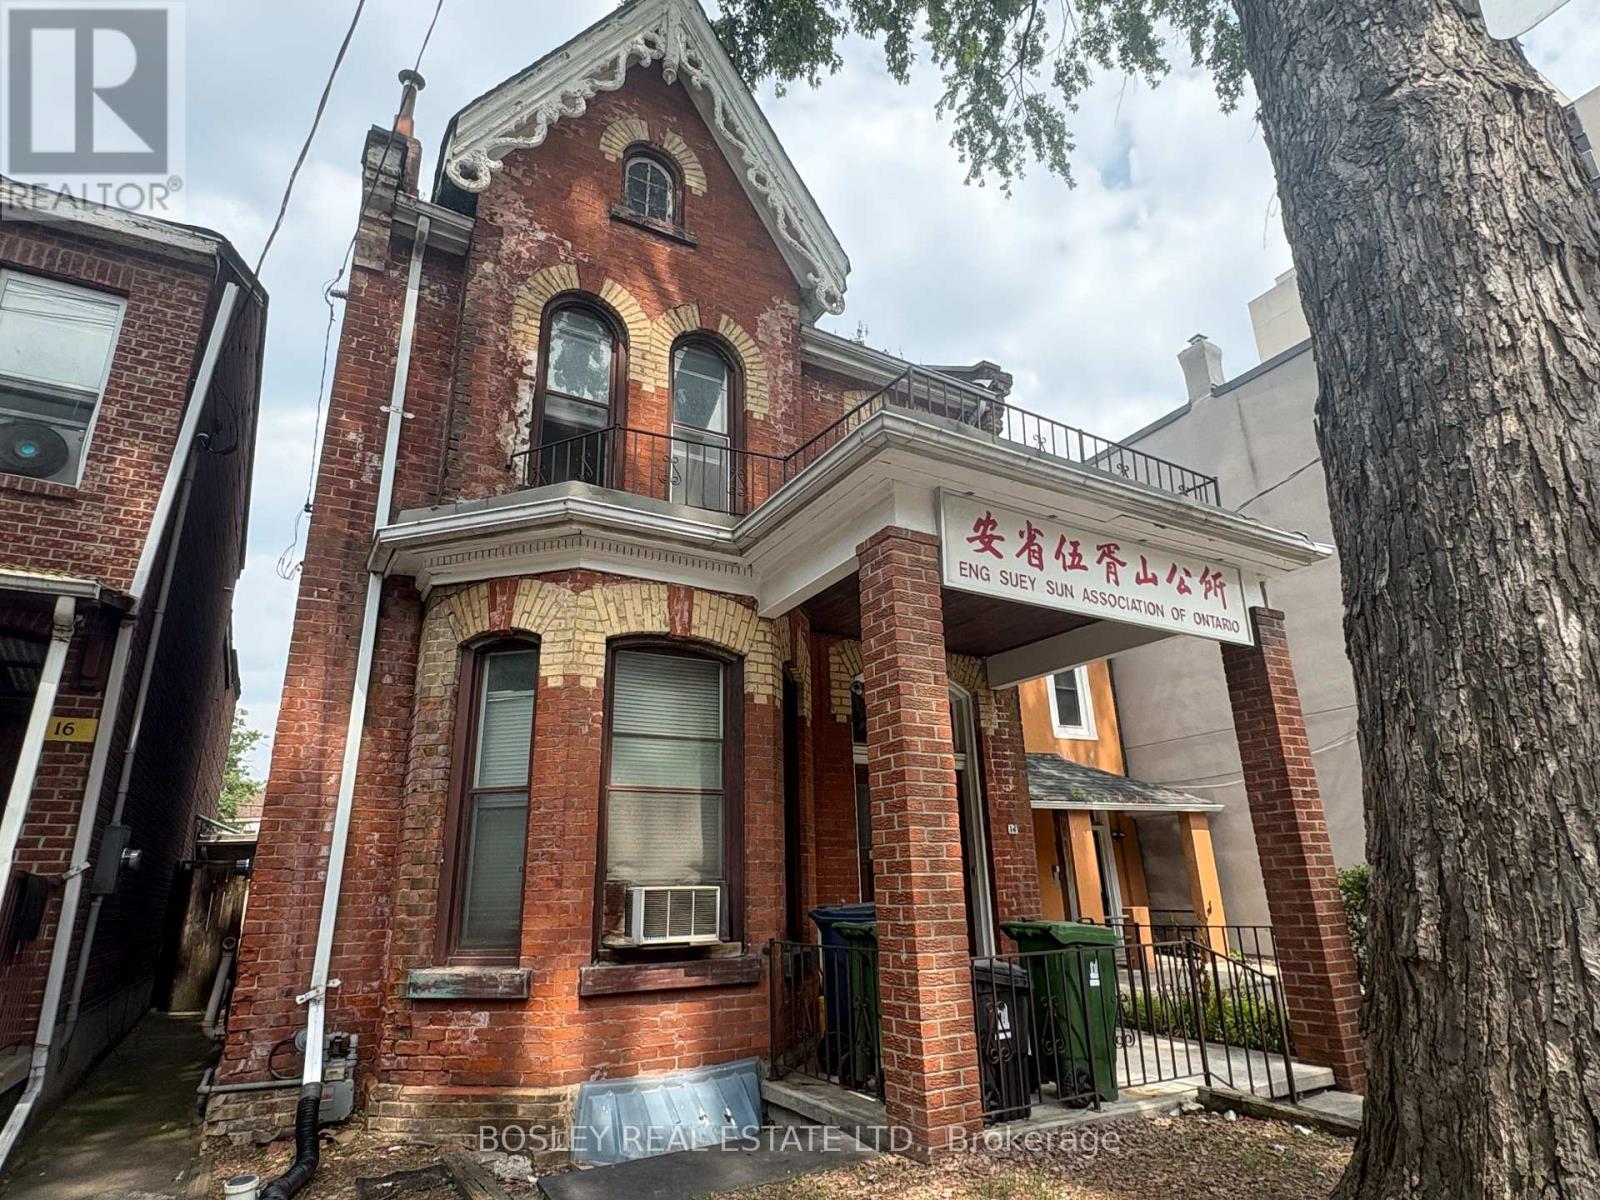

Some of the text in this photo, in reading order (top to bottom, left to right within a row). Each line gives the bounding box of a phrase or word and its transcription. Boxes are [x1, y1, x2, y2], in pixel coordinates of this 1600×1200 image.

[959, 560, 1241, 633] ENG SUEY SUN ASSOCIATION OF ONTARIO
[966, 510, 1227, 610] 安省伍胥山公所
[54, 721, 76, 736] 16
